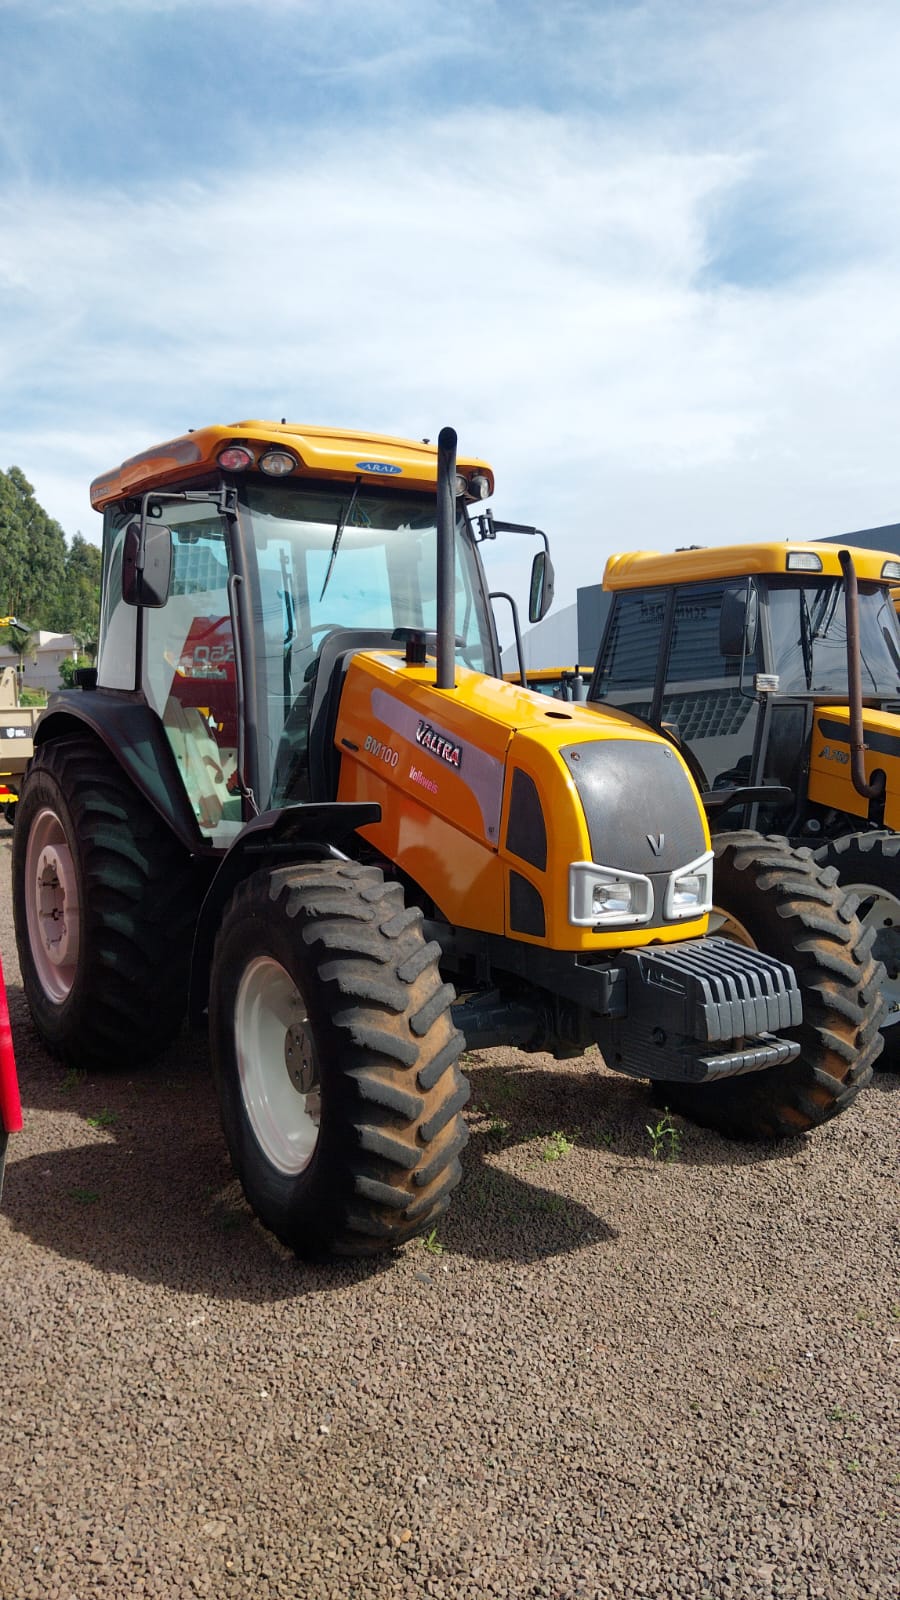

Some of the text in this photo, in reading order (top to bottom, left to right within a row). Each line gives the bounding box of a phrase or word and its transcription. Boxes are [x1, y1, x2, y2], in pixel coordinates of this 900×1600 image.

[363, 463, 398, 473] ARAL
[364, 735, 399, 767] BM100
[415, 720, 462, 767] VALTRA
[646, 833, 665, 857] V
